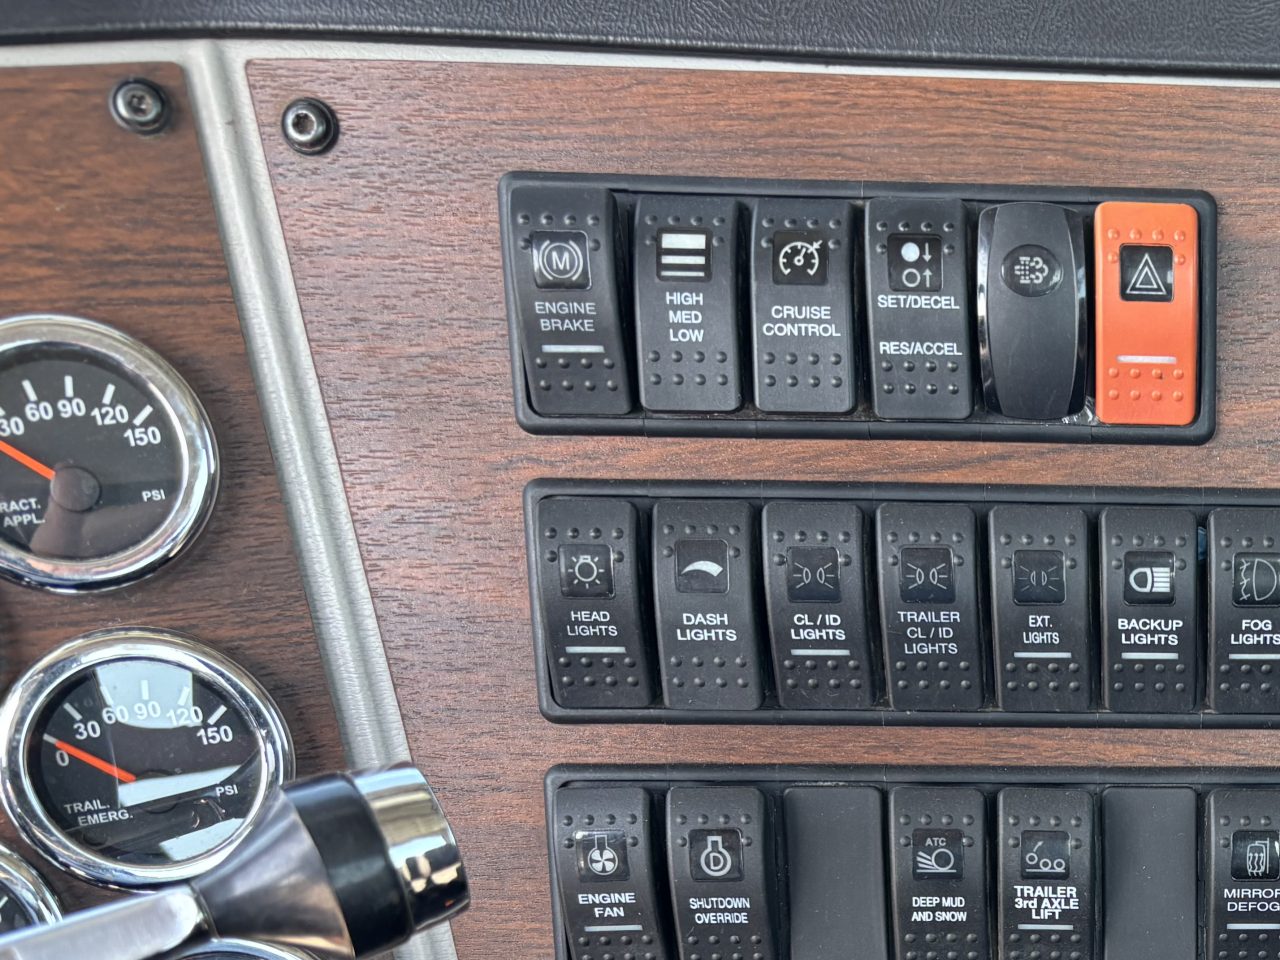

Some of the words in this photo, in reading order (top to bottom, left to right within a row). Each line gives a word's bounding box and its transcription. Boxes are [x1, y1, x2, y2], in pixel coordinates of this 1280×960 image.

[665, 292, 704, 306] HIGH
[877, 295, 960, 309] SET/DECEL
[535, 301, 596, 315] ENGINE
[771, 306, 831, 319] CRUISE
[668, 310, 703, 324] MED
[540, 319, 595, 332] BRAKE
[763, 323, 841, 337] CONTROL
[669, 329, 704, 342] LOW
[879, 342, 962, 356] RES/ACCEL
[25, 401, 53, 421] 60
[57, 398, 86, 418] 90
[90, 404, 129, 426] 120
[123, 426, 161, 447] 150
[141, 489, 166, 502] PSI
[3, 513, 46, 528] APPL.
[571, 611, 610, 622] HEAD
[683, 613, 728, 626] DASH
[793, 614, 814, 626] CL
[825, 614, 841, 626] ID
[897, 611, 961, 623] TRAILER
[1029, 615, 1053, 628] EXT.
[566, 625, 618, 637] LIGHTS
[1118, 618, 1183, 631] BACKUP
[1241, 620, 1272, 631] FOG
[677, 629, 737, 642] LIGHTS
[790, 629, 846, 641] LIGHTS
[907, 627, 925, 639] CL
[939, 627, 953, 639] ID
[1023, 632, 1059, 645] LIGHTS
[1121, 633, 1179, 646] LIGHTS
[904, 643, 958, 655] LIGHTS
[102, 705, 129, 725] 60
[134, 701, 161, 720] 90
[166, 706, 203, 727] 120
[73, 720, 101, 740] 30
[196, 725, 233, 746] 150
[55, 751, 70, 767] 0
[215, 785, 239, 797] PSI
[63, 799, 110, 815] TRAIL.
[77, 809, 134, 827] EMERG.
[925, 836, 946, 848] ATC
[1013, 885, 1077, 898] TRAILER
[578, 892, 636, 905] ENGINE
[689, 897, 750, 910] SHUTDOWN
[912, 896, 940, 909] DEEP
[941, 896, 966, 909] MUD
[1014, 897, 1038, 910] 3rd
[1041, 897, 1080, 910] AXLE
[594, 906, 625, 919] FAN
[1227, 901, 1280, 912] DEFOG
[694, 912, 749, 925] OVERRIDE
[911, 911, 935, 923] AND
[934, 911, 968, 923] SNOW
[1031, 908, 1062, 921] LIFT
